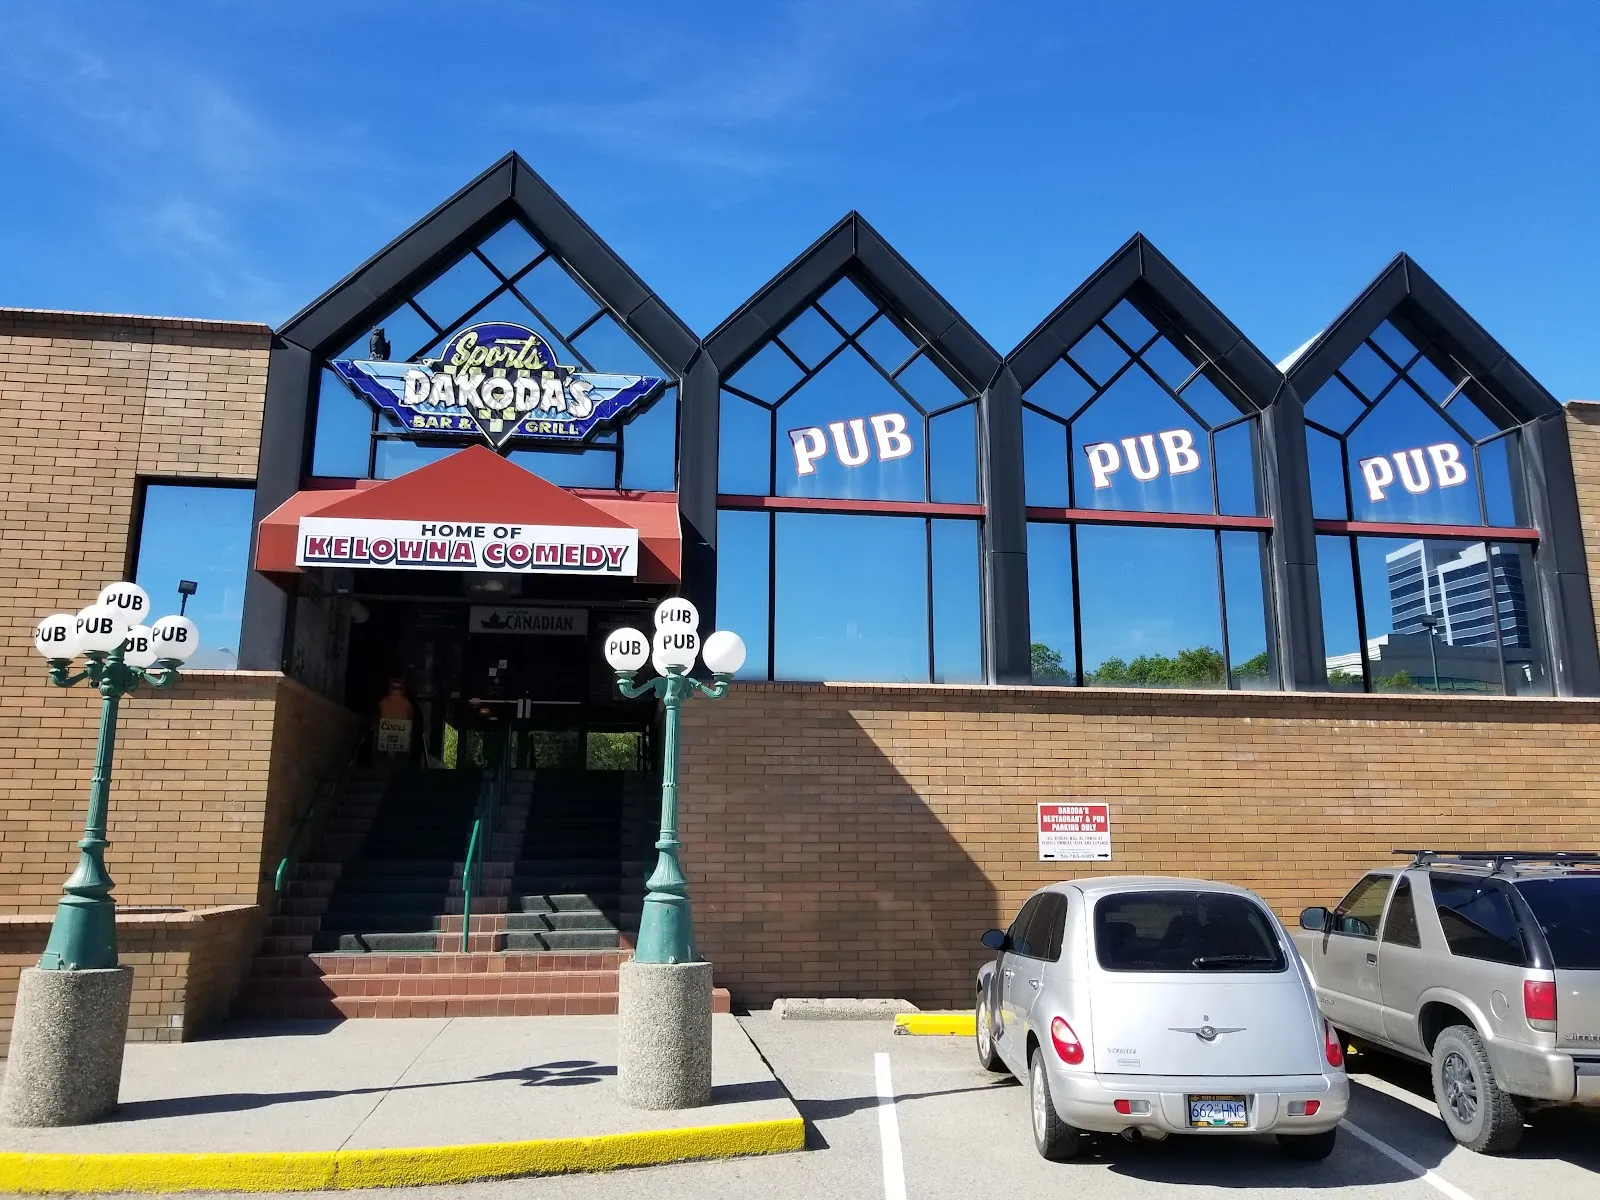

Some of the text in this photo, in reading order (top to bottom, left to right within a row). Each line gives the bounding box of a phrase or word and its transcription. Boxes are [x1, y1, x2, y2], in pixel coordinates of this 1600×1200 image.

[450, 331, 548, 376] Sports
[404, 369, 594, 418] DAKODA'S
[411, 415, 579, 435] BAR & GRILL
[787, 411, 914, 476] PUB
[1083, 427, 1200, 490] PUB
[1358, 441, 1468, 503] PUB
[421, 524, 522, 540] HOME OF
[303, 534, 629, 571] KELOWNA COMEDY
[106, 593, 143, 611] PUB
[505, 615, 574, 631] CANADIAN
[660, 609, 692, 624] PUB
[76, 617, 113, 634] PUB
[152, 626, 188, 643] PUB
[663, 634, 695, 650] PUB
[610, 640, 641, 656] PUB
[381, 719, 406, 731] Coors
[1058, 806, 1089, 814] DAKODA'S
[1042, 815, 1105, 823] RESTAURANT & PUB
[1051, 823, 1097, 831] PARKING ONLY
[1192, 1103, 1214, 1118] 662
[1221, 1103, 1245, 1118] HNC
